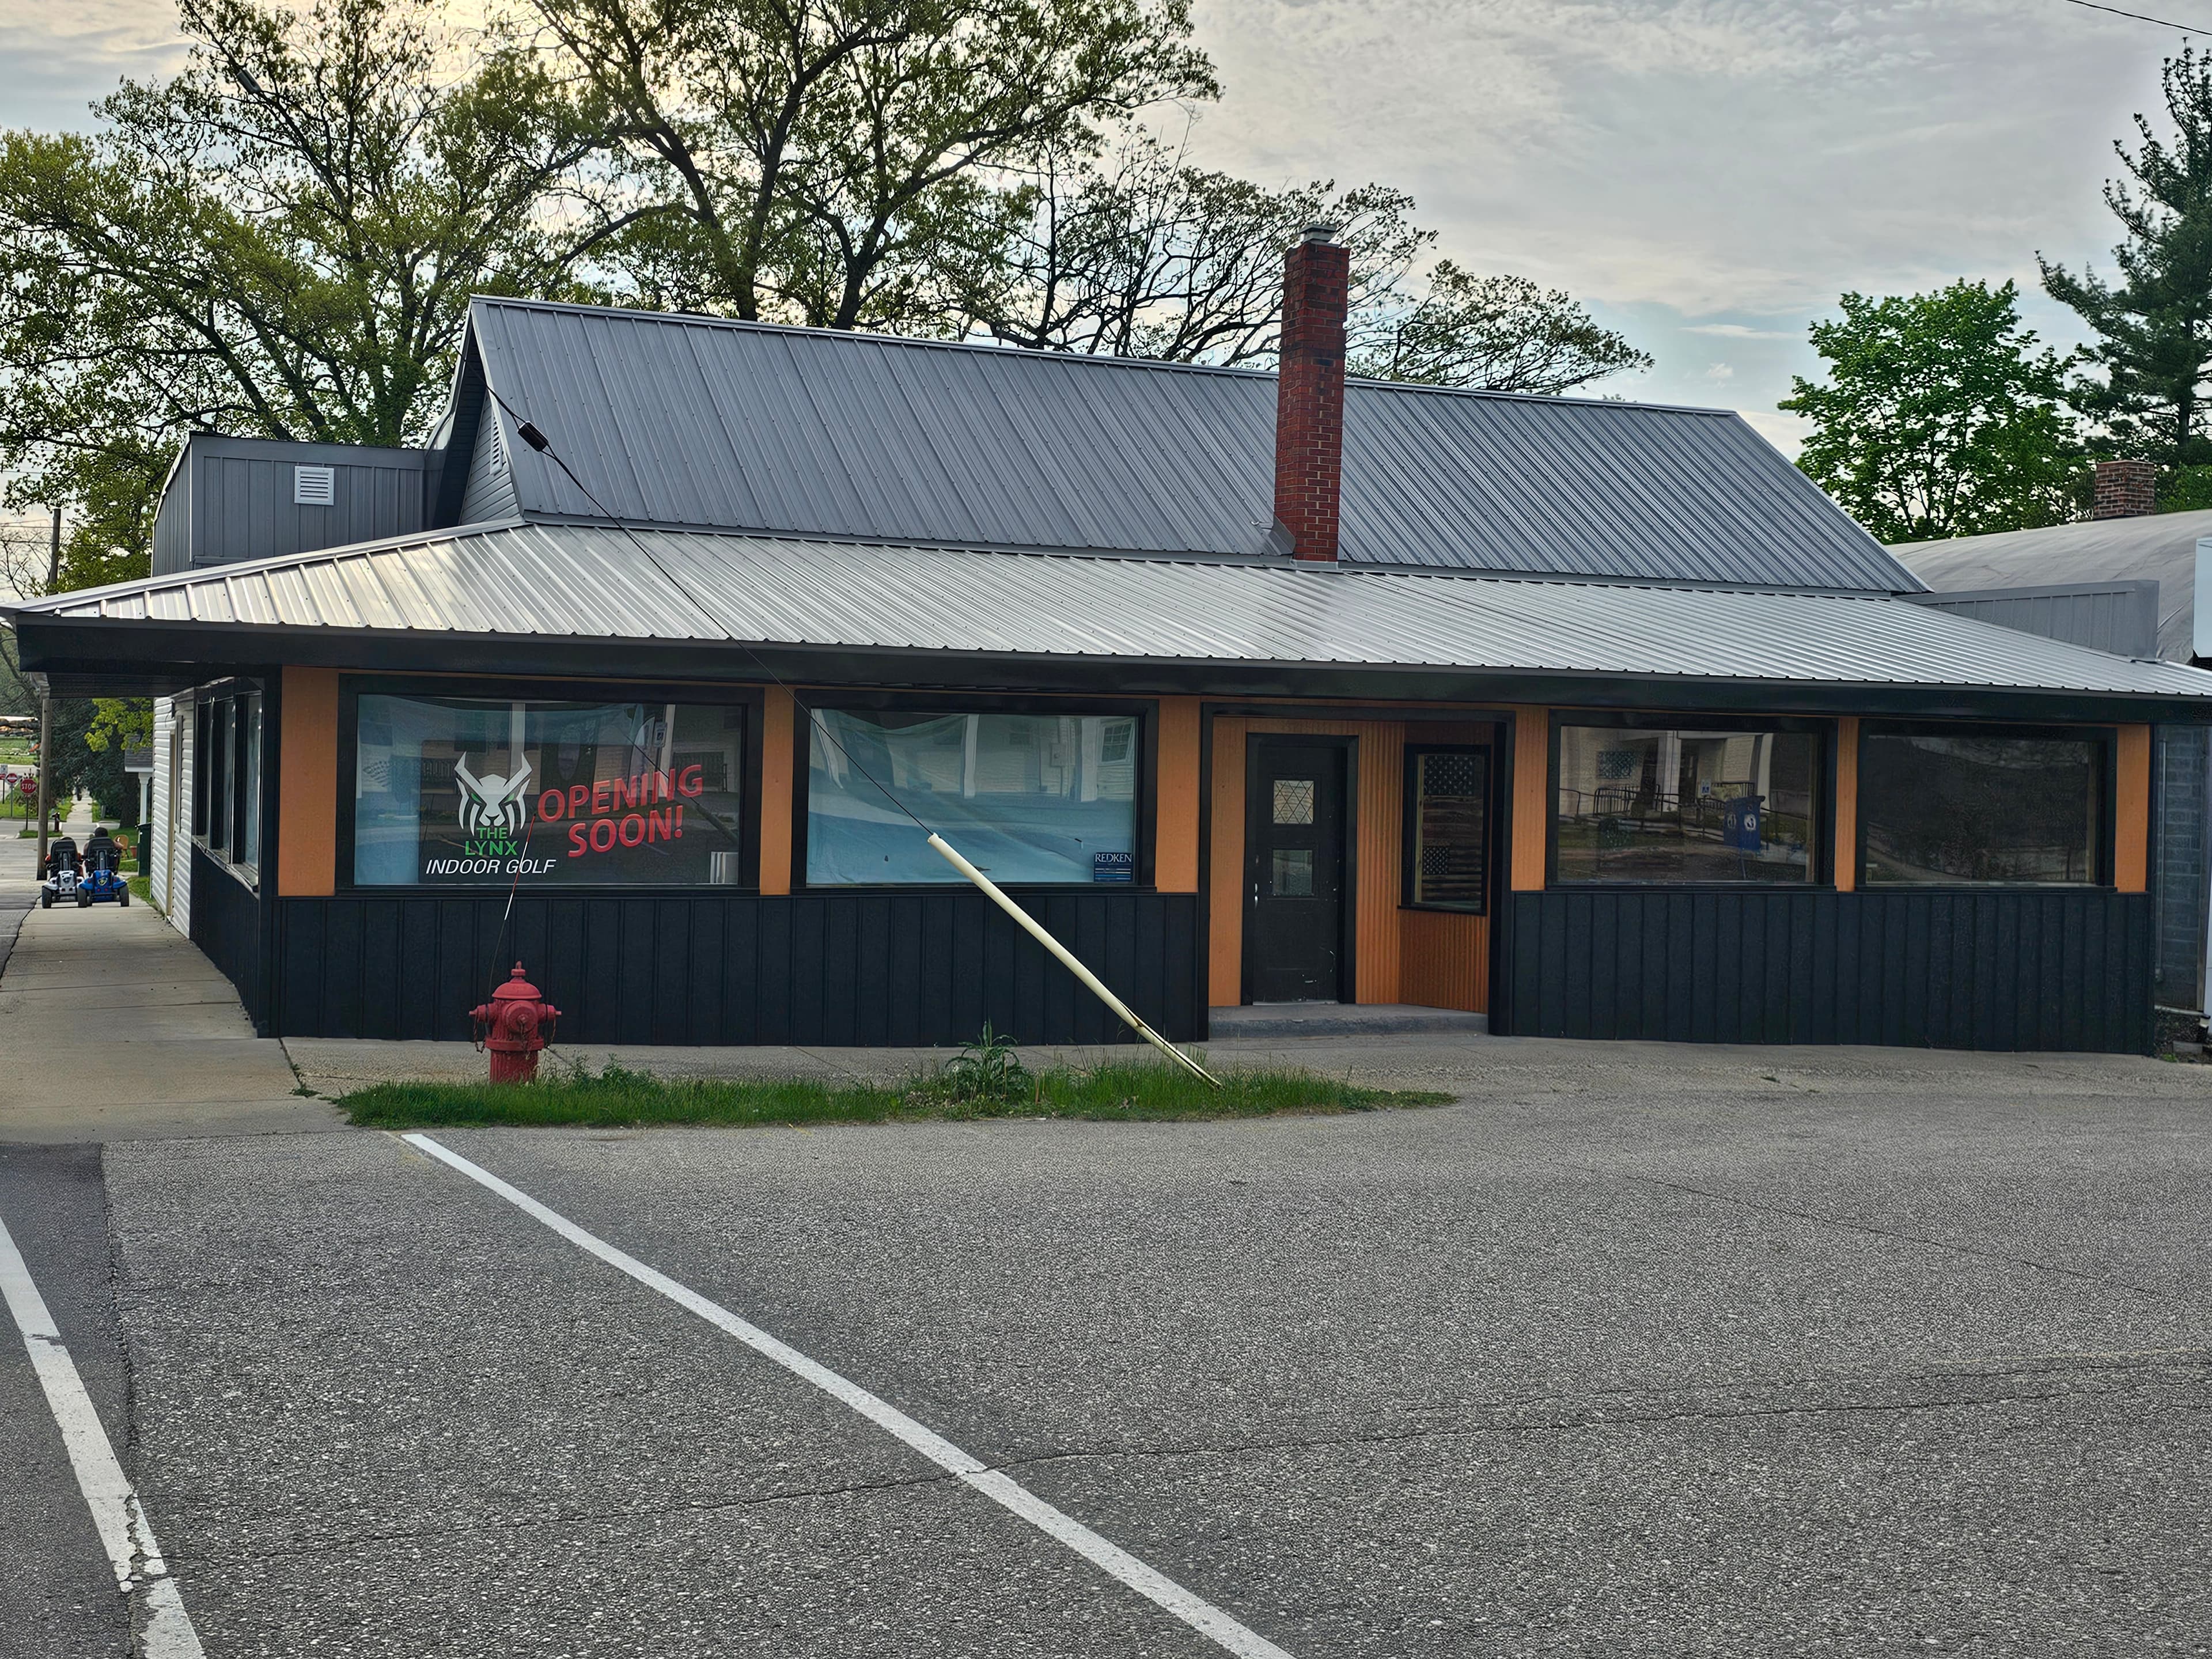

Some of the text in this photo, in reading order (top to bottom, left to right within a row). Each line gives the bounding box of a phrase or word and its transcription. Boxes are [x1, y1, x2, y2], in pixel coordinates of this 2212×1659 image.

[537, 764, 703, 823] OPENING
[476, 827, 507, 839] THE
[568, 805, 683, 858] SOON!
[465, 840, 518, 856] LYNX
[1094, 853, 1132, 862] REDKEN
[426, 859, 557, 874] INDOOR GOLF
